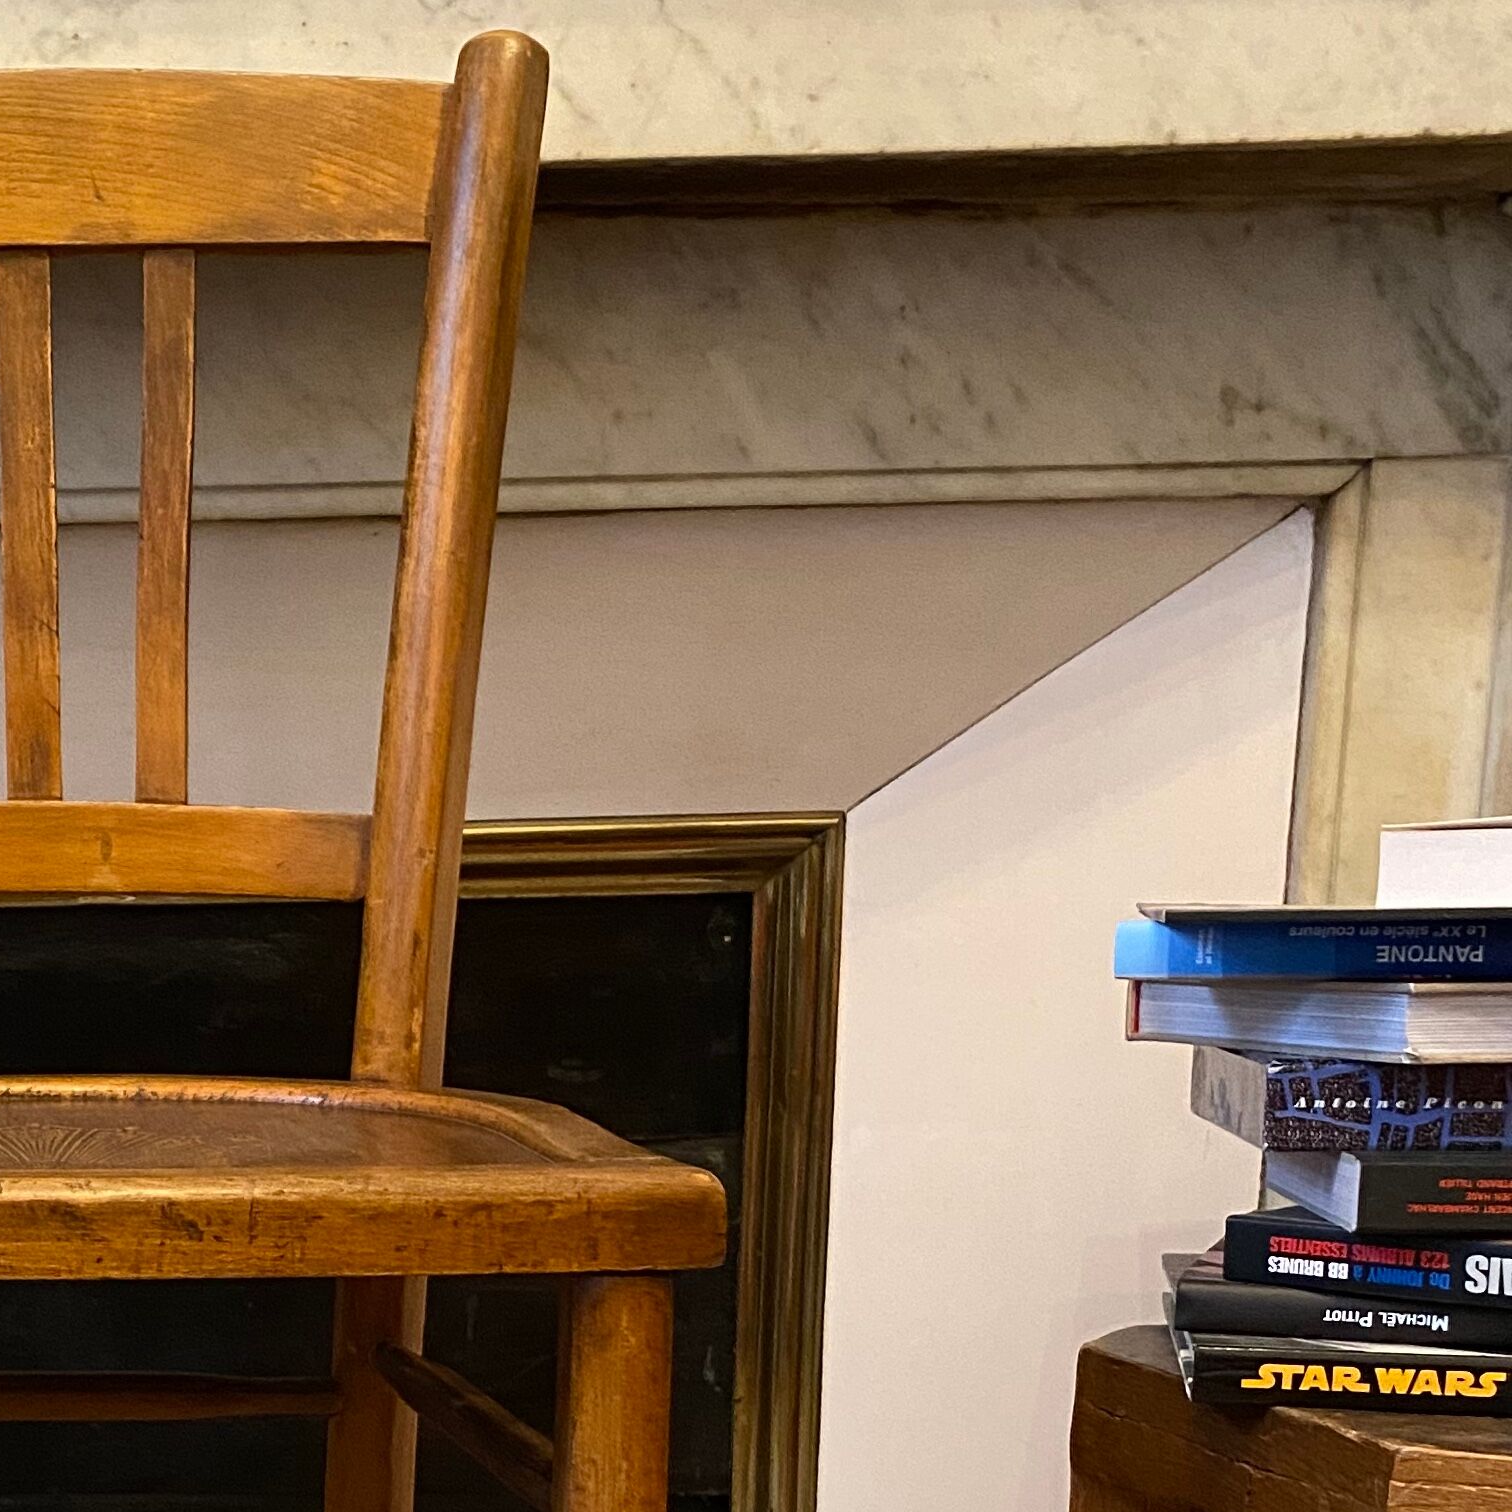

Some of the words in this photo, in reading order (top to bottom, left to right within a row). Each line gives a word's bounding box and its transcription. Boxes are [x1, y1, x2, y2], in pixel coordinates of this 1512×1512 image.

[1289, 925, 1356, 938] couleurs
[1359, 926, 1380, 937] en
[1383, 926, 1429, 939] siècle
[1466, 925, 1487, 938] Le
[1376, 945, 1484, 963] PANTONE
[1294, 1096, 1406, 1110] Antoine
[1423, 1097, 1504, 1110] Picon
[1269, 1236, 1348, 1259] ESSENTIELS
[1351, 1243, 1415, 1266] ALBUMS
[1267, 1255, 1324, 1277] BRUNES
[1327, 1260, 1349, 1280] BB
[1420, 1251, 1451, 1270] 123
[1366, 1267, 1424, 1288] JOHNNY
[1240, 1363, 1371, 1394] STAR
[1374, 1367, 1507, 1398] WARS
